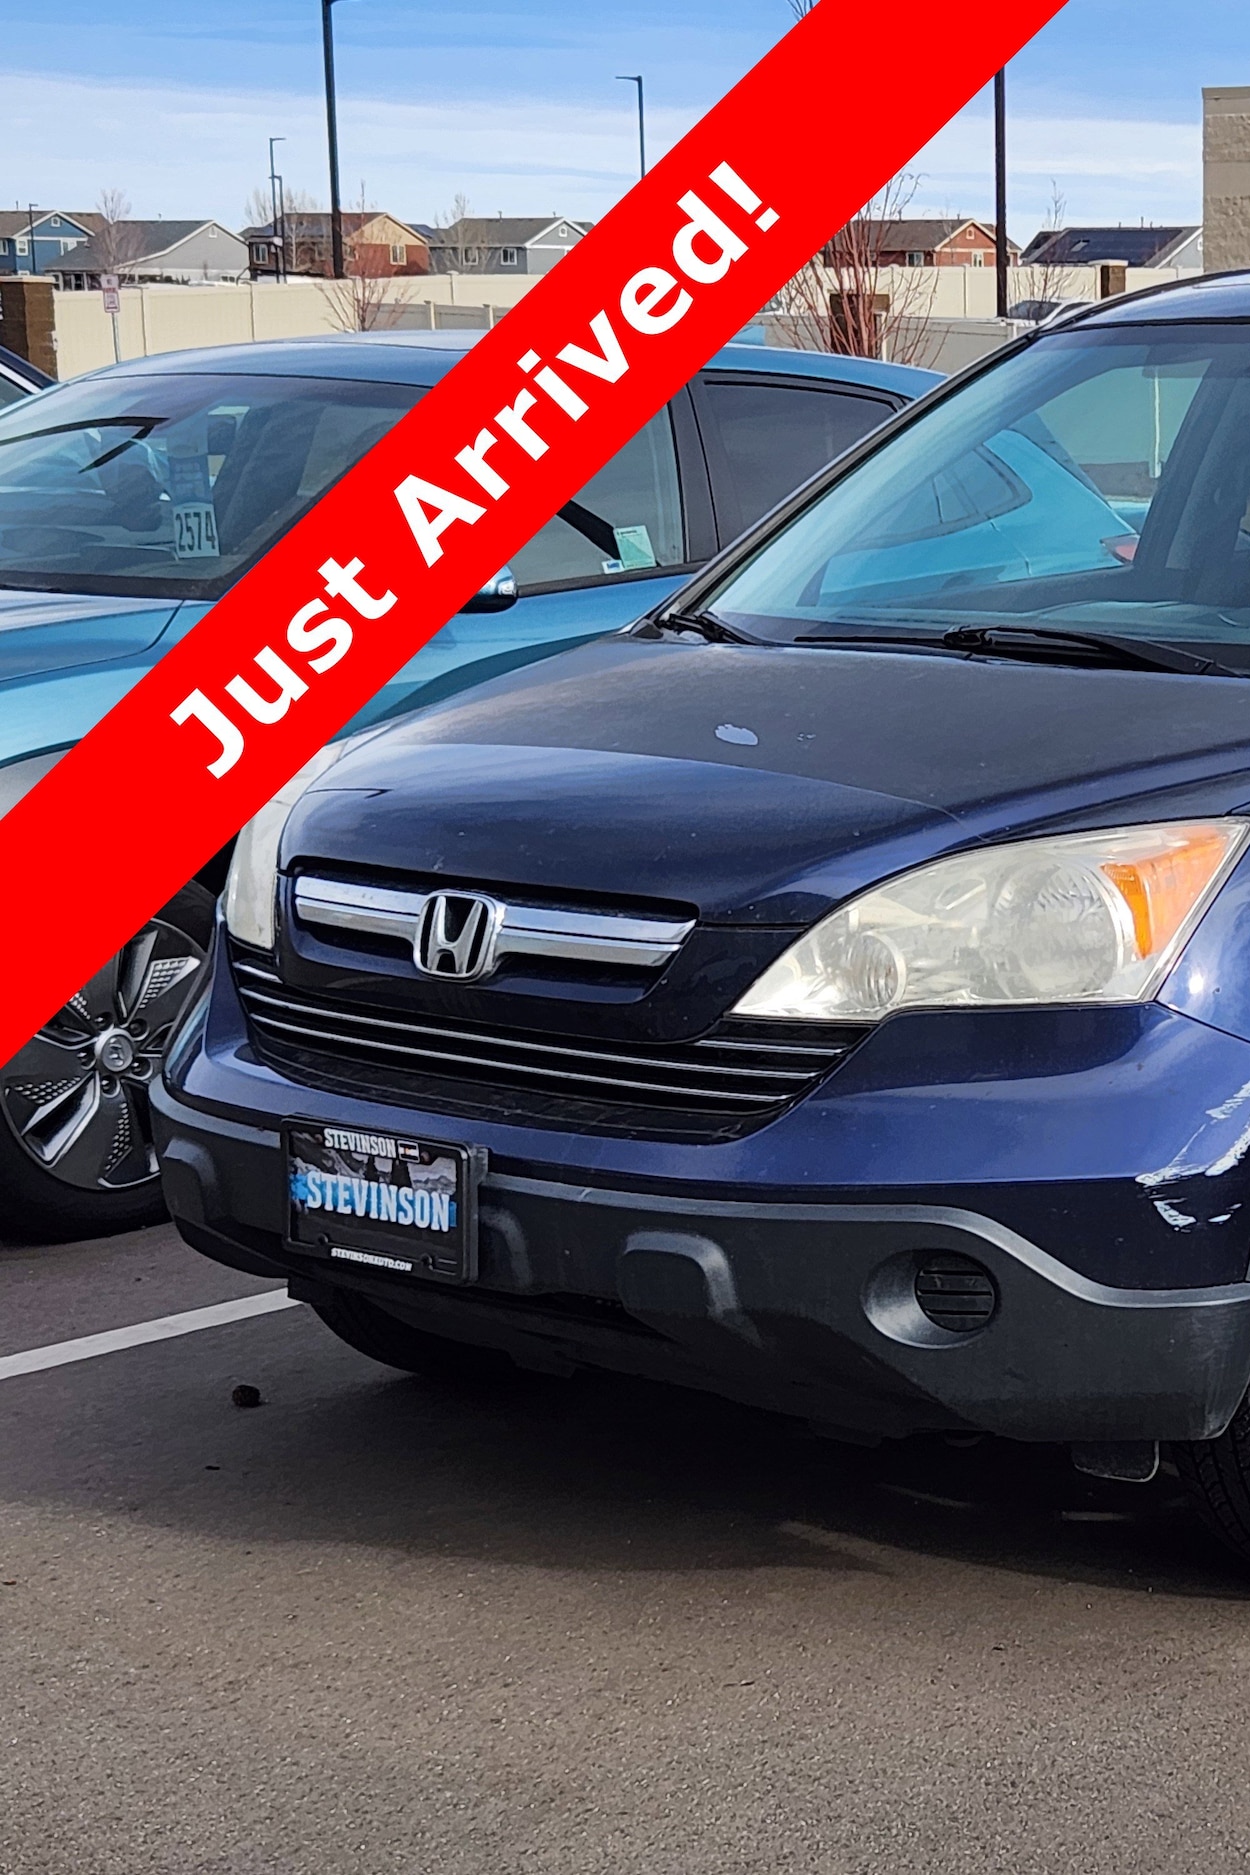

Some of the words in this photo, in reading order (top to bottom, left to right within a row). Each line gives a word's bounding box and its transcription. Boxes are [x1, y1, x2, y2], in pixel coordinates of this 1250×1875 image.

[175, 511, 216, 552] 2574
[323, 1128, 397, 1158] STEVINSON
[306, 1170, 450, 1232] STEVINSON
